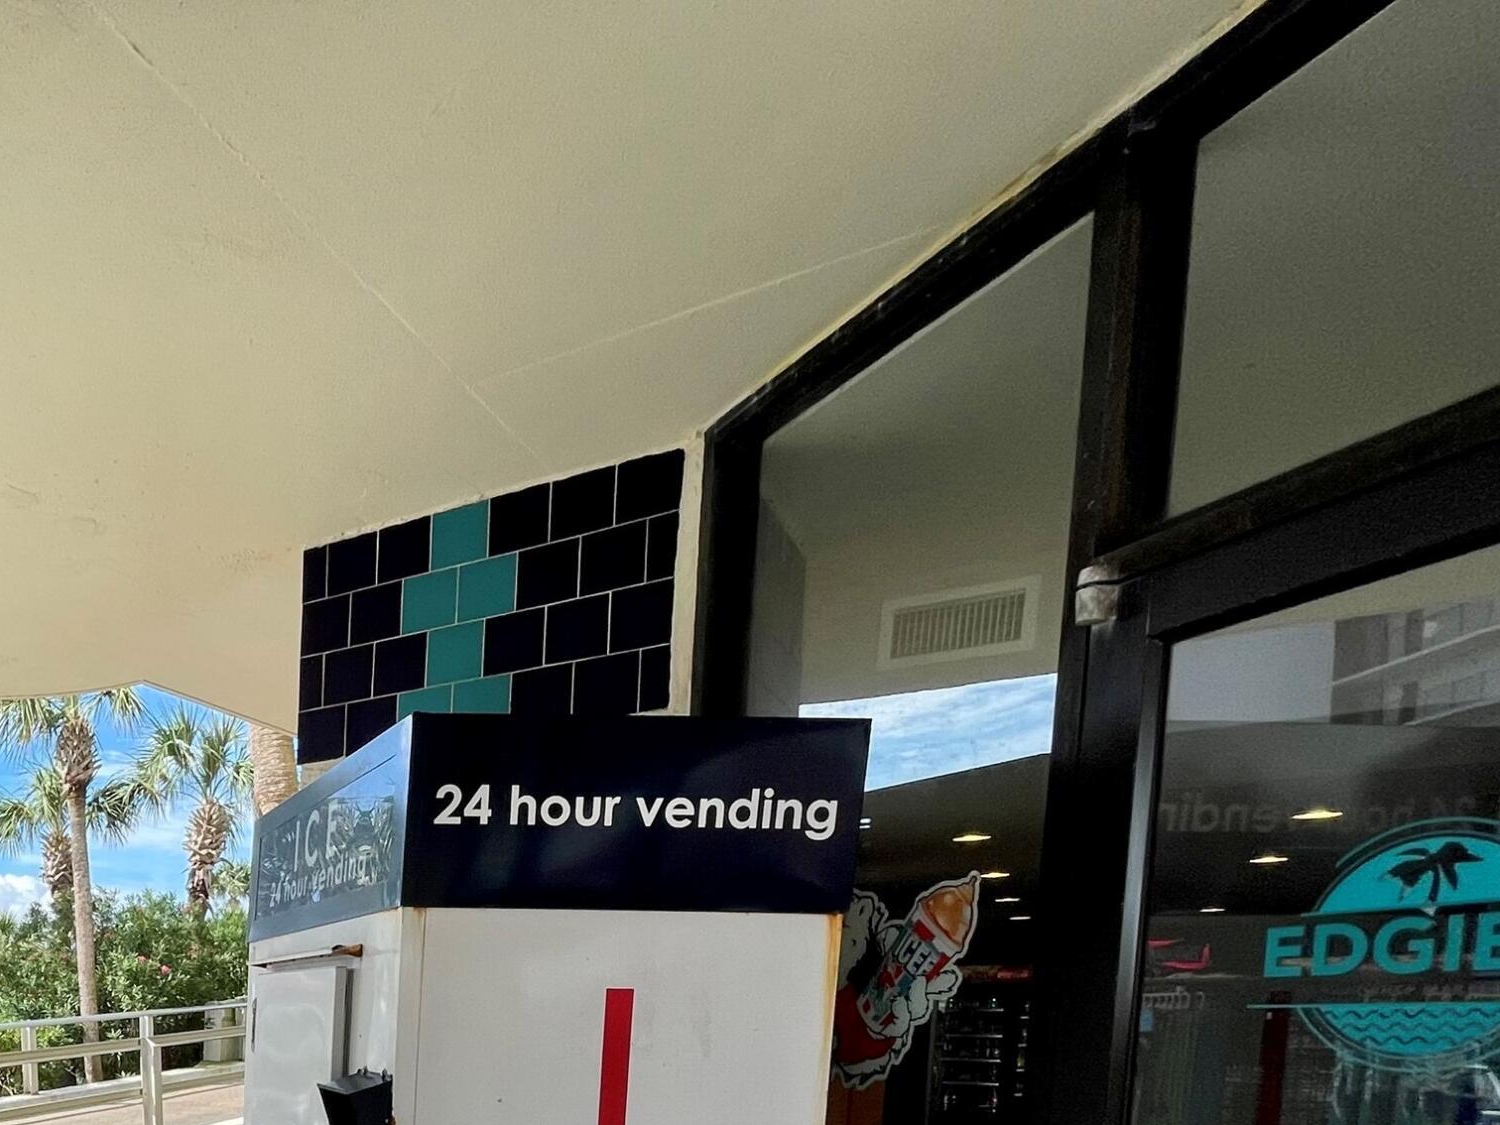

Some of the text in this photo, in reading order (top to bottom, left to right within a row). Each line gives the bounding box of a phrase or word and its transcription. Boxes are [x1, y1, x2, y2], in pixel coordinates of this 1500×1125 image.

[433, 783, 839, 841] 24 hour vending
[283, 875, 308, 902] hour
[311, 853, 368, 895] vending
